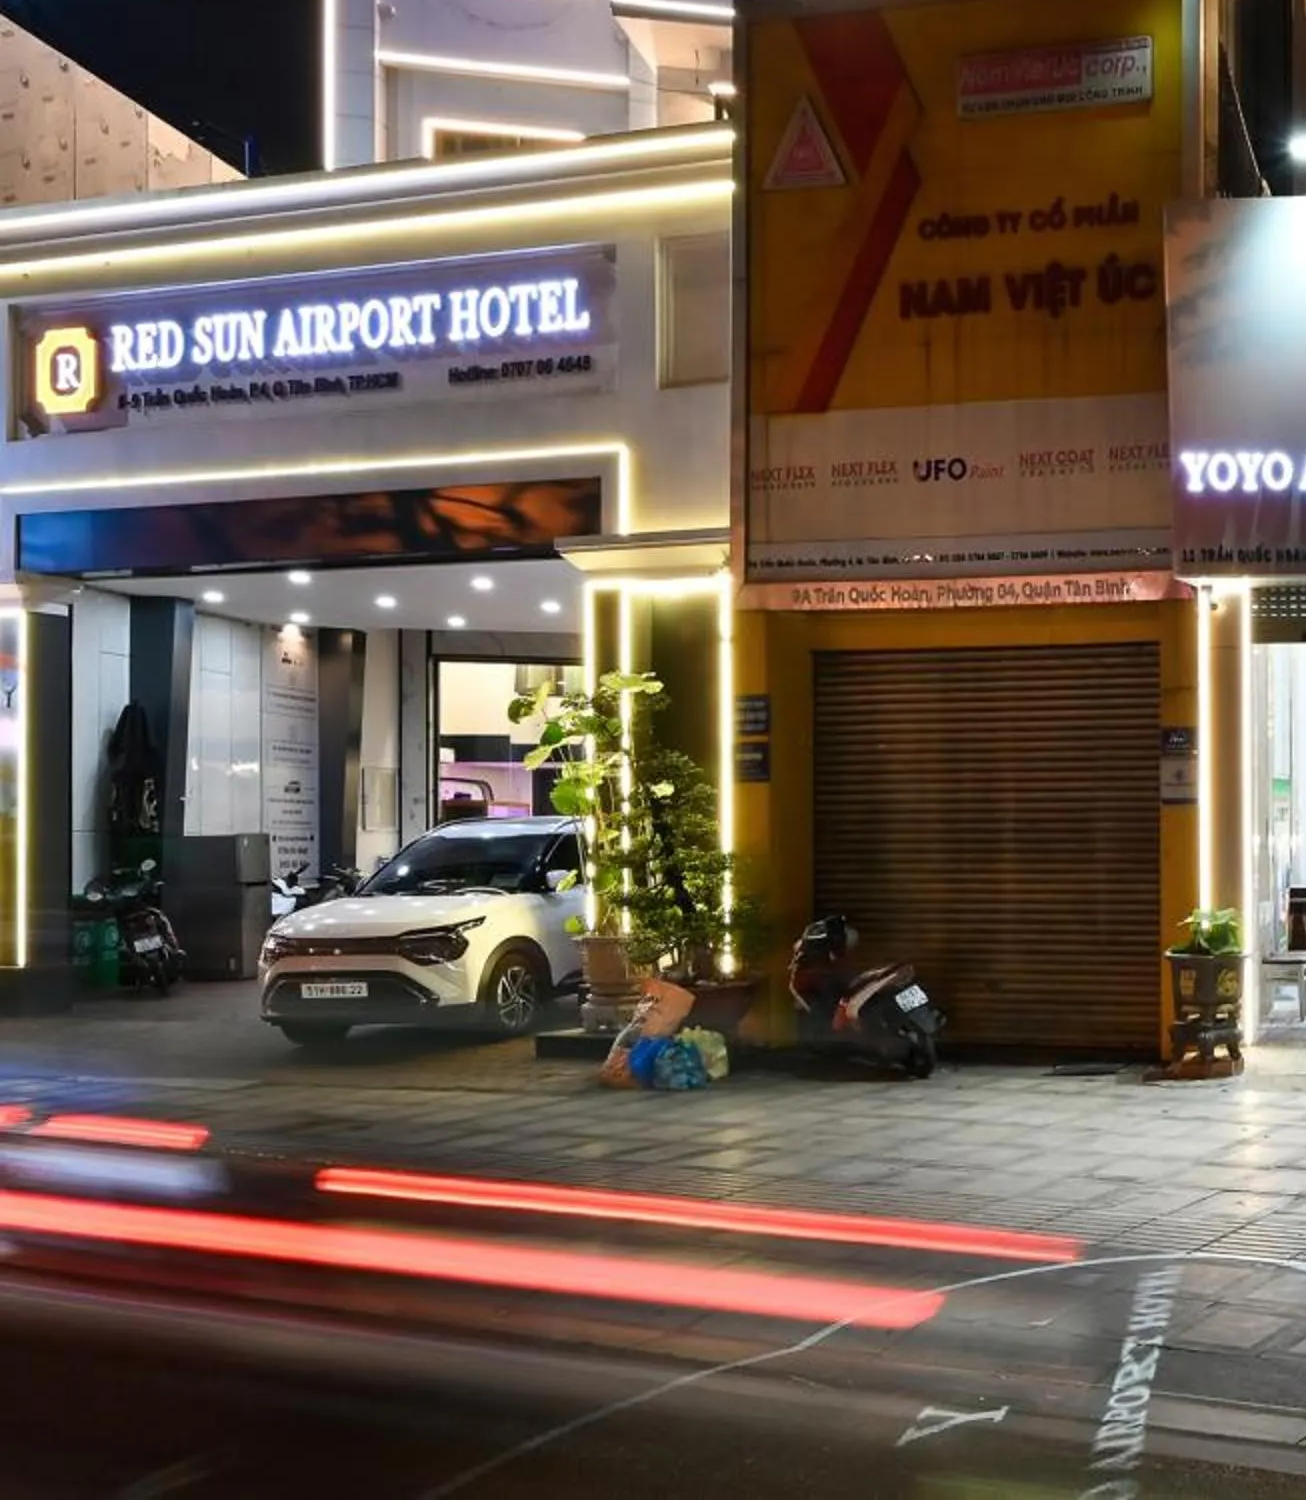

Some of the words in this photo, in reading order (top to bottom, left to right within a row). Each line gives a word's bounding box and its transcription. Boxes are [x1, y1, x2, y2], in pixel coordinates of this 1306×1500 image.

[918, 213, 991, 241] CÔNG
[996, 210, 1023, 234] TY
[900, 274, 991, 322] NAM
[1005, 260, 1087, 320] VIỆT
[1097, 252, 1157, 306] ÚC
[110, 320, 185, 373] RED
[191, 310, 268, 365] SUN
[273, 292, 442, 358] AIRPORT
[448, 276, 591, 343] HOTEL
[55, 352, 80, 390] R
[912, 457, 967, 482] UFO
[1180, 451, 1294, 494] YOYO
